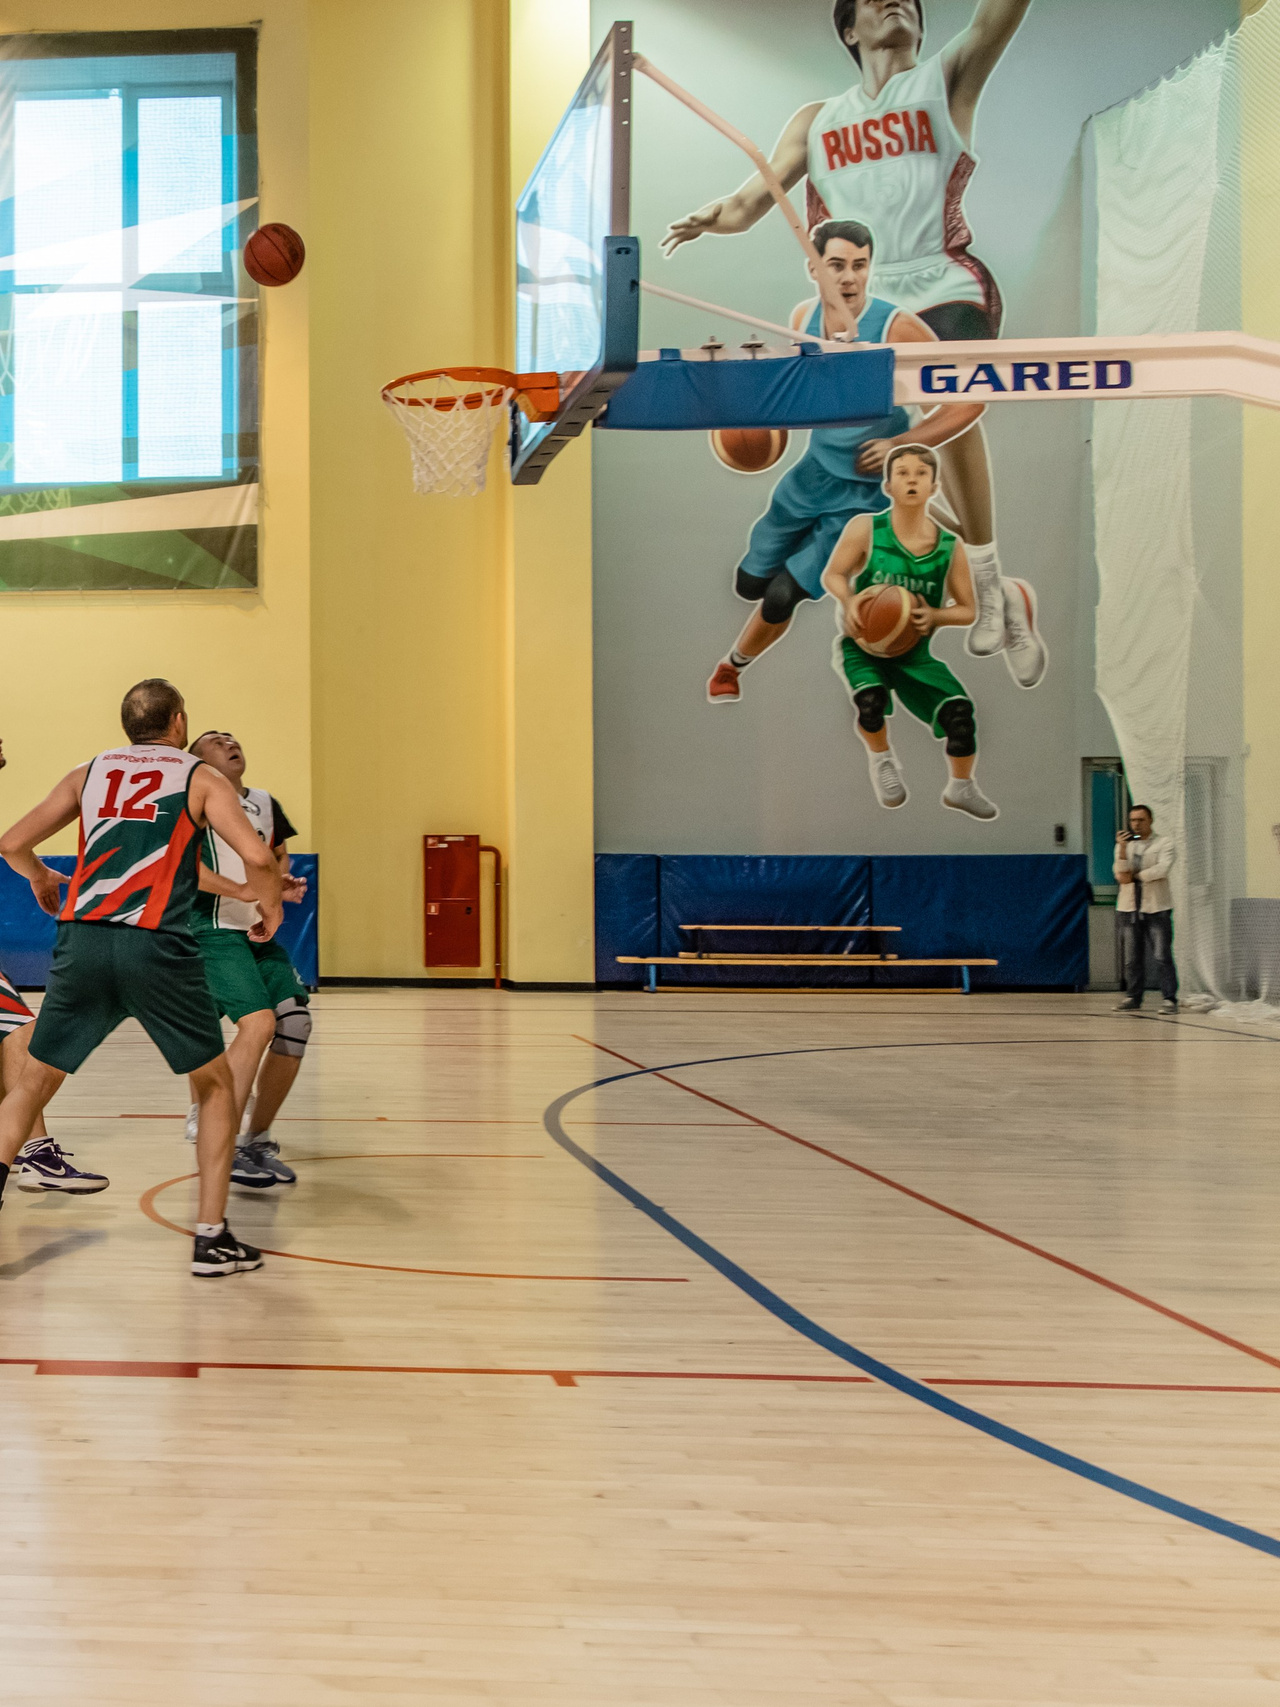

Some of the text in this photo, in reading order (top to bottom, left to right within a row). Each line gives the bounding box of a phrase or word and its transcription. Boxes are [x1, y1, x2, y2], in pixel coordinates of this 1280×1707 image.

[821, 110, 938, 171] RUSSIA
[920, 360, 1133, 394] GARED
[97, 768, 164, 823] 12
